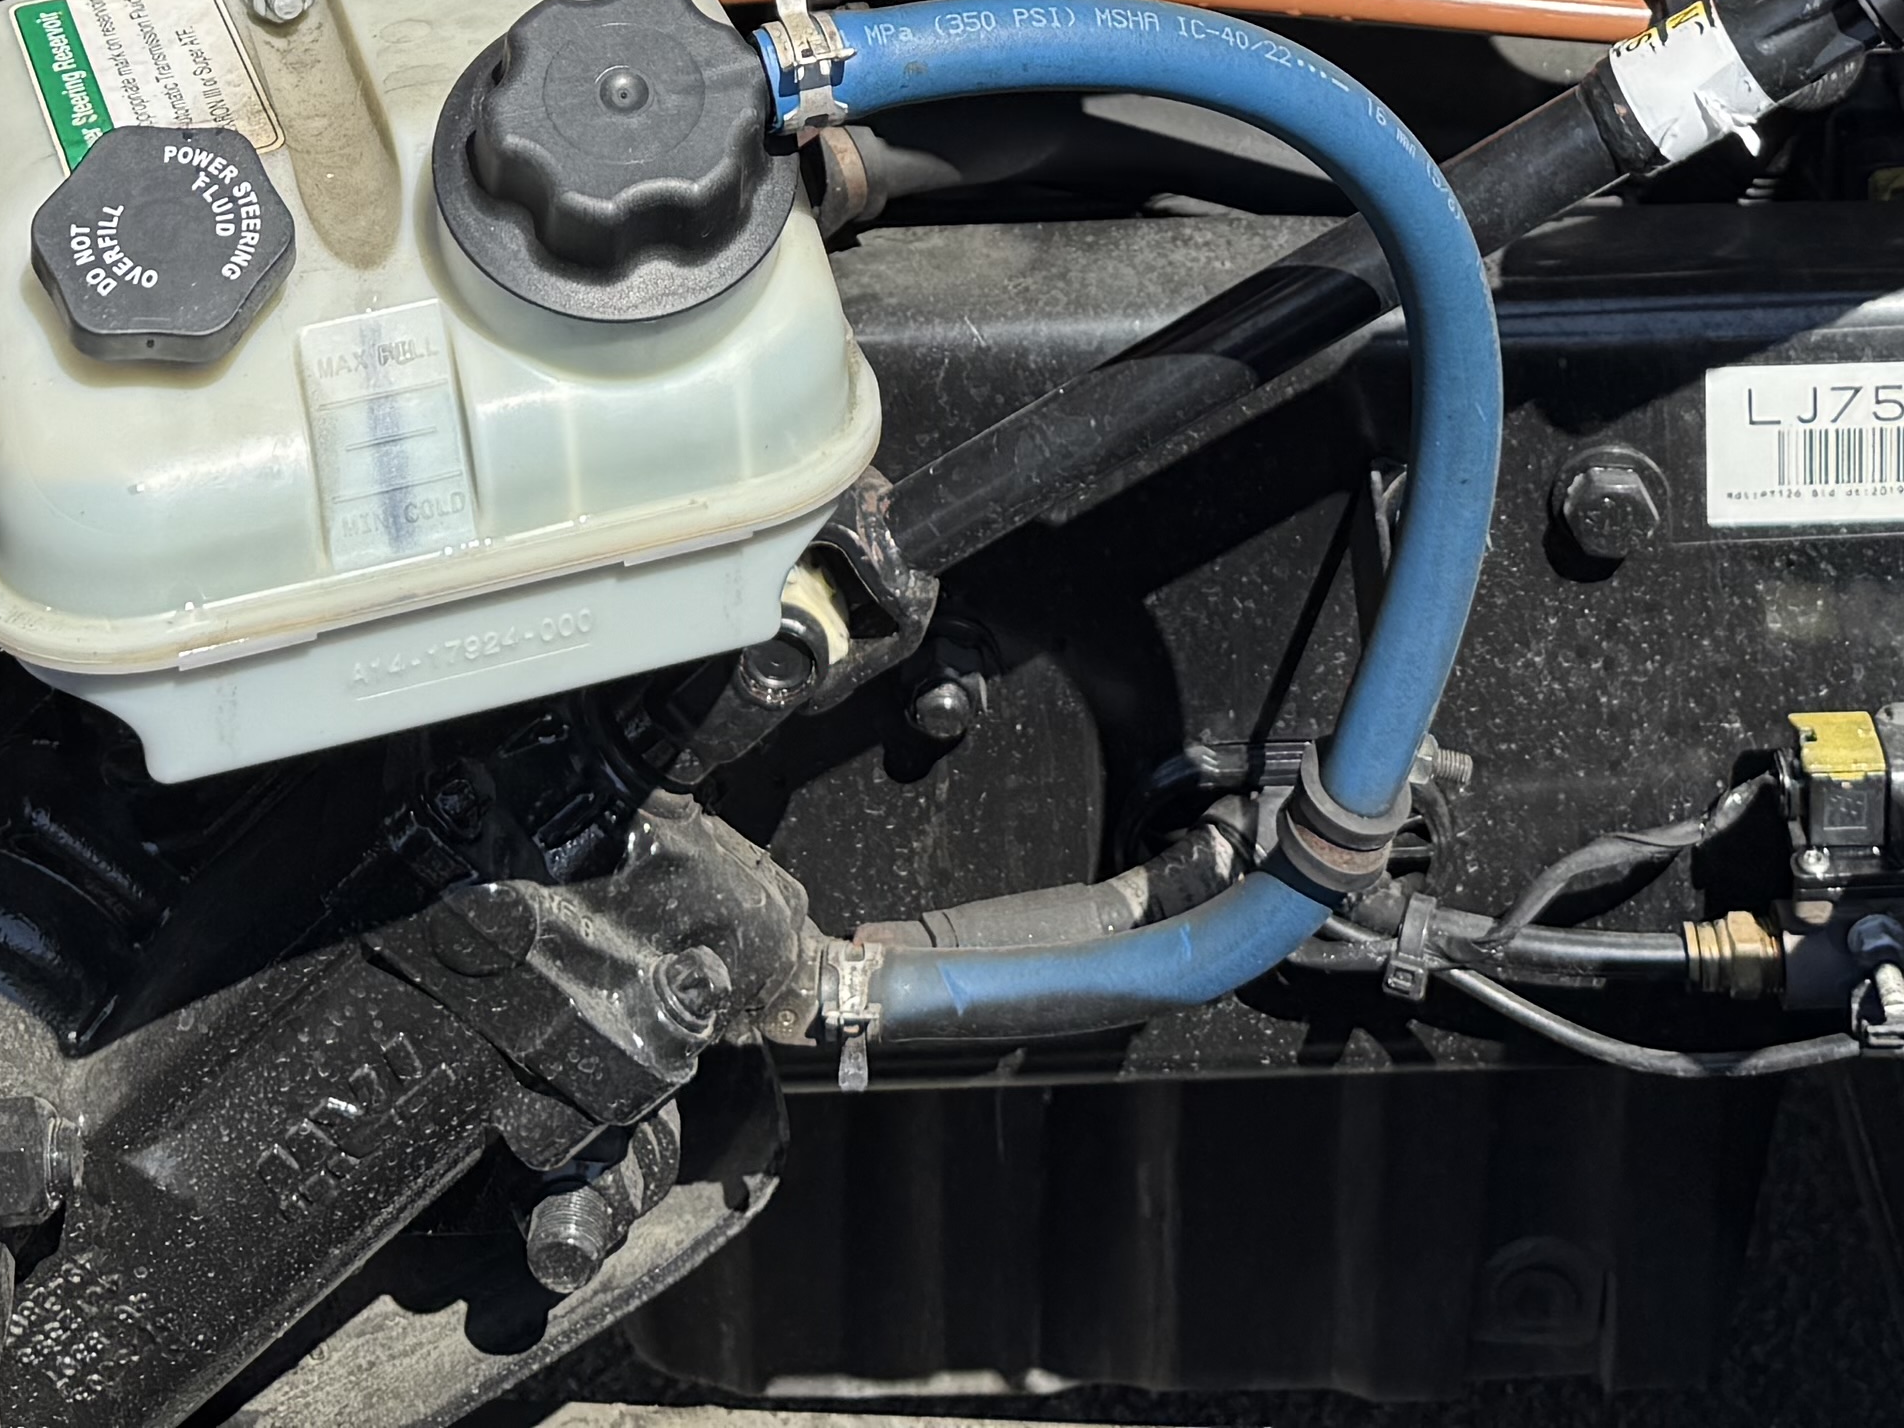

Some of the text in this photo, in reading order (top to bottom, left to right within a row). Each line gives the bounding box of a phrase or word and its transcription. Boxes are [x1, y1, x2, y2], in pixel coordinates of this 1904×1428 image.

[31, 5, 105, 129] Steering Reservoir
[104, 34, 123, 52] on
[106, 49, 133, 79] mark
[132, 17, 174, 84] Transmission
[865, 23, 913, 45] MPa
[934, 10, 997, 35] (350
[1013, 6, 1076, 28] PSI)
[1097, 6, 1159, 32] MSHA
[1367, 97, 1387, 127] 16
[163, 145, 262, 281] POWER STEERING
[191, 170, 236, 237] FLUID
[70, 223, 118, 297] DO NOT
[96, 204, 159, 289] OVERFILL
[316, 349, 370, 379] MAX
[342, 492, 466, 538] MIN COLD
